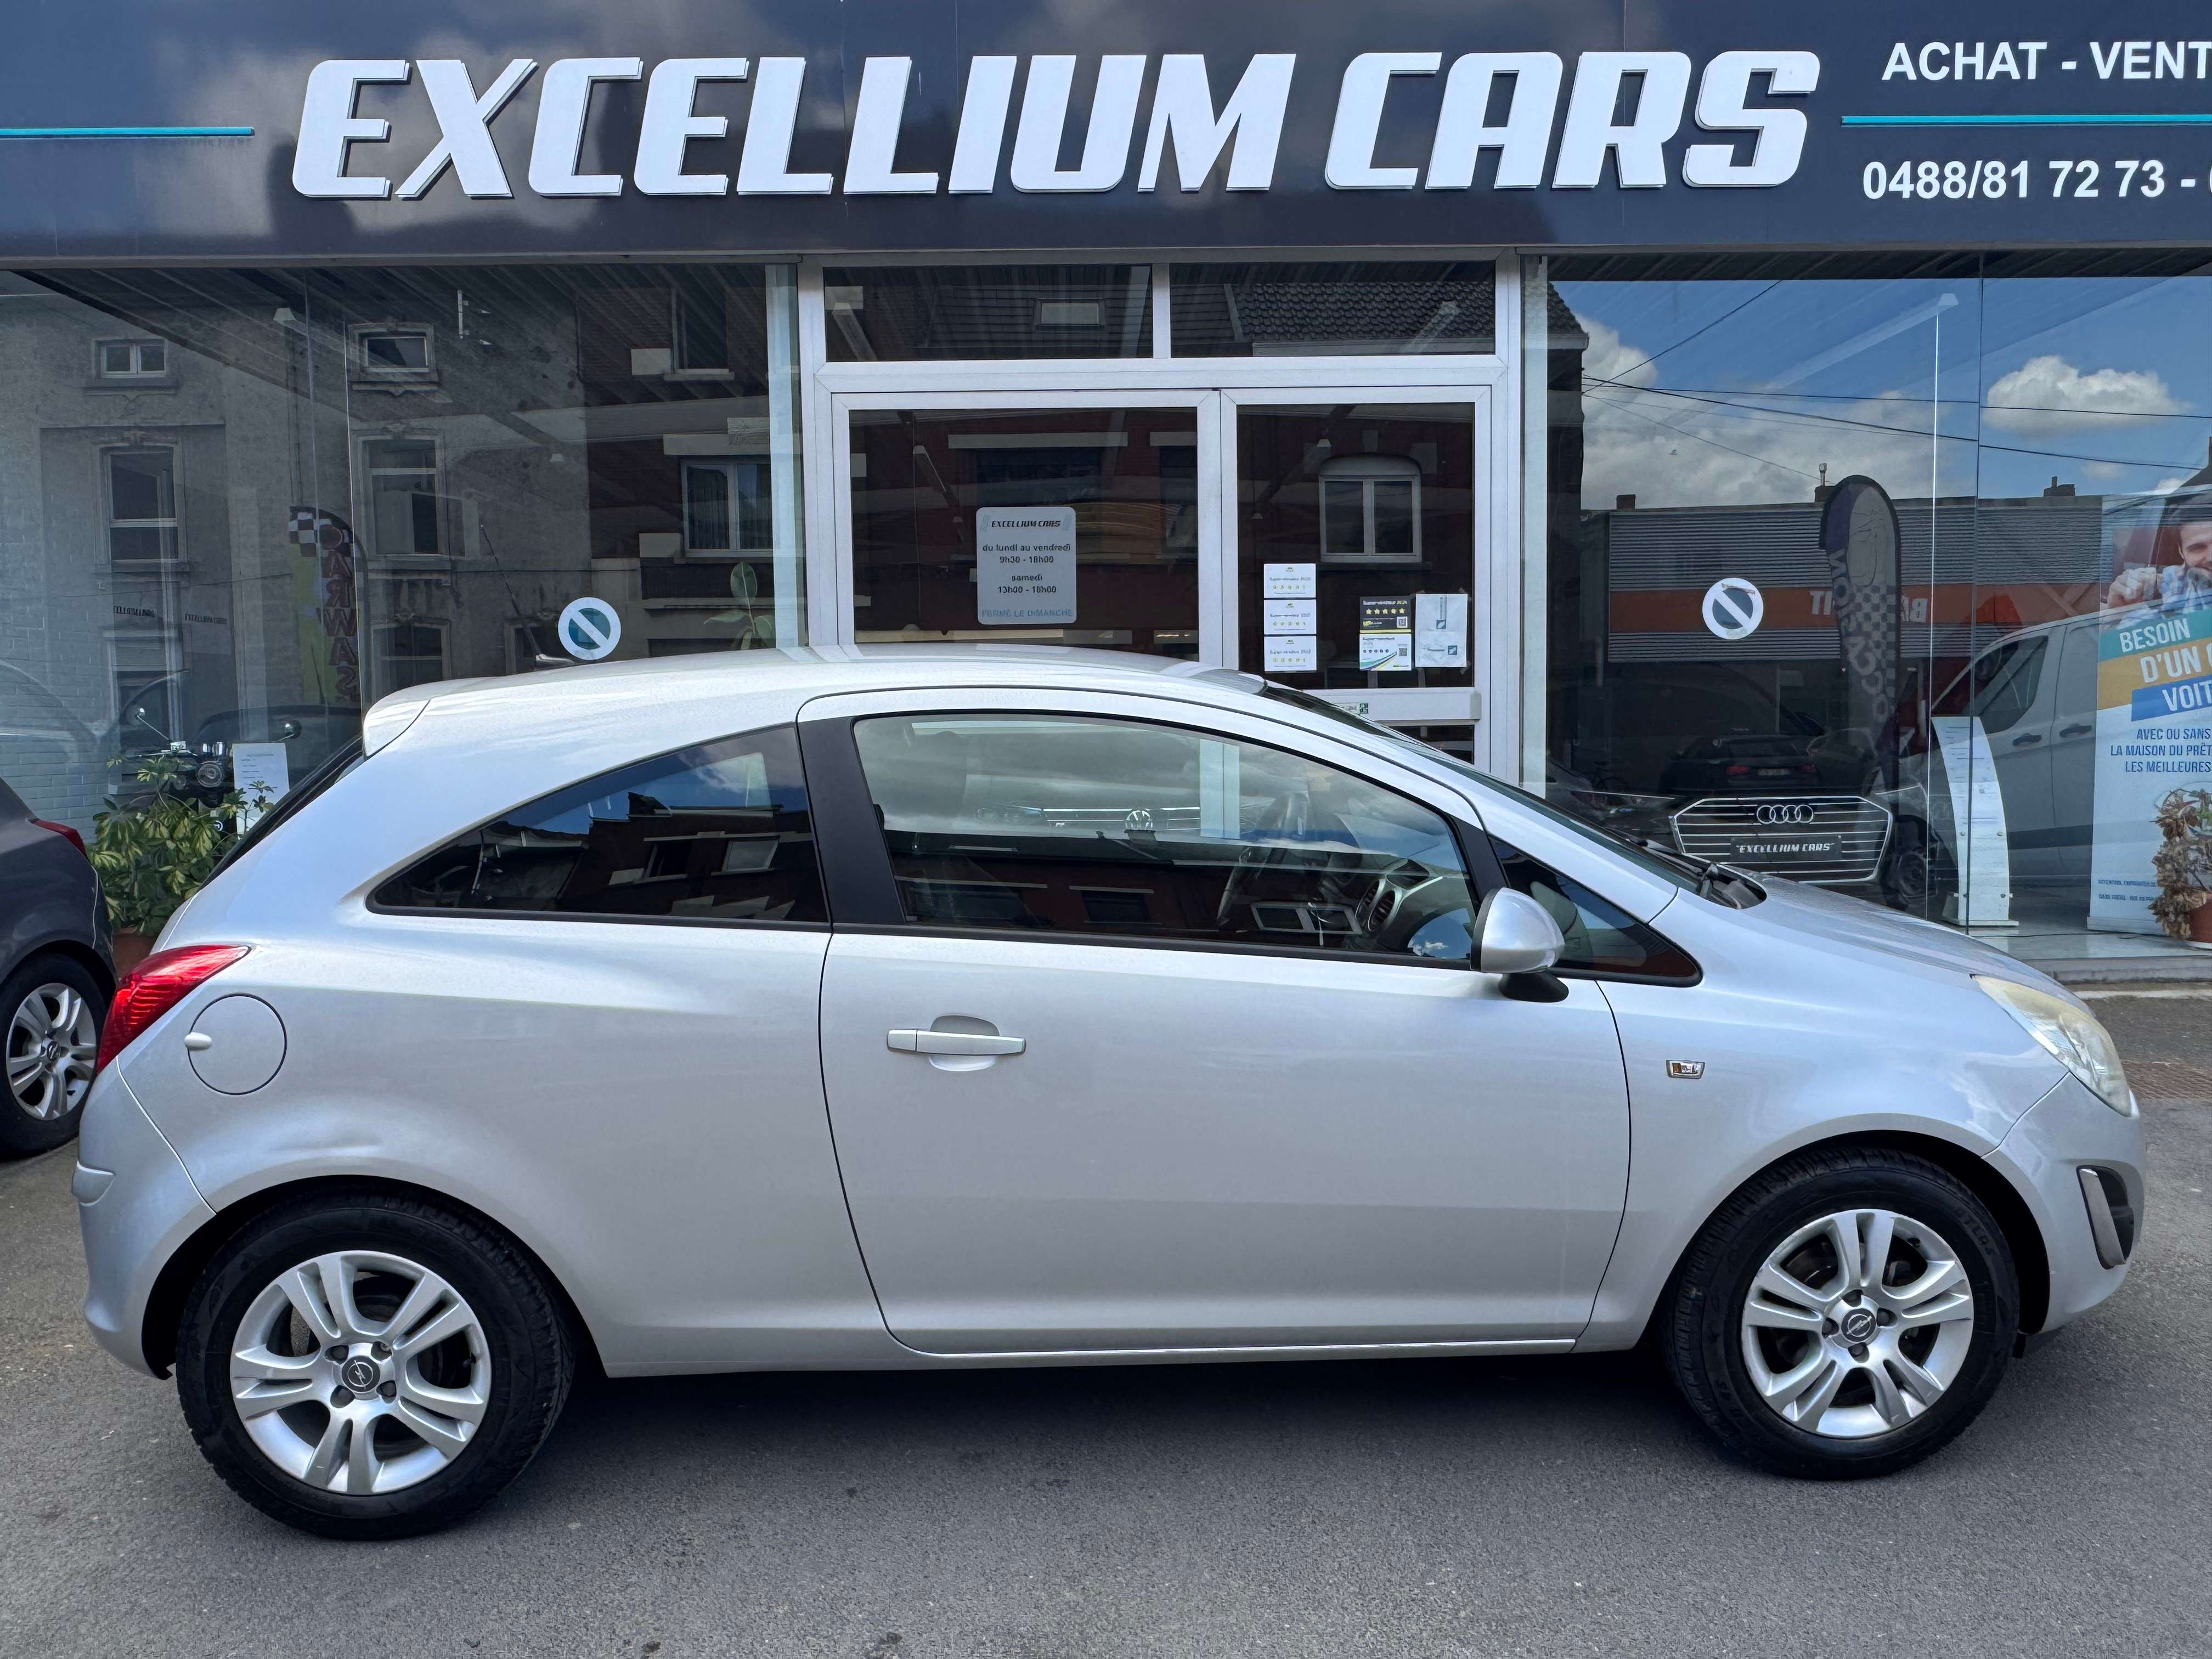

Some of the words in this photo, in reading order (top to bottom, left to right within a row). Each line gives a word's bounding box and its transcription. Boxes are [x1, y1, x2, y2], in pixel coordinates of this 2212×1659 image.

[1882, 41, 2047, 81] ACHAT
[2062, 60, 2077, 70] -
[2089, 41, 2212, 80] VENT
[292, 53, 1296, 199] EXCELLIUM
[1324, 50, 1821, 190] CARS
[1863, 160, 2028, 199] 0488/81
[2048, 160, 2099, 198] 72
[2114, 160, 2165, 198] 73
[1027, 609, 1073, 617] DIMANCHE
[2119, 618, 2191, 653] BESOIN
[2140, 646, 2202, 683] D'UN
[2162, 680, 2212, 712] VOIT
[2136, 728, 2164, 740] AVEC
[2166, 728, 2180, 740] OU
[2183, 728, 2211, 740] SANS
[2111, 745, 2123, 756] LA
[2125, 745, 2165, 756] MAISON
[2169, 745, 2183, 756] DU
[2125, 761, 2143, 772] LES
[2146, 761, 2211, 772] MEILLEURES
[1739, 844, 1800, 853] EXCELLIUM
[1802, 843, 1831, 851] CARS
